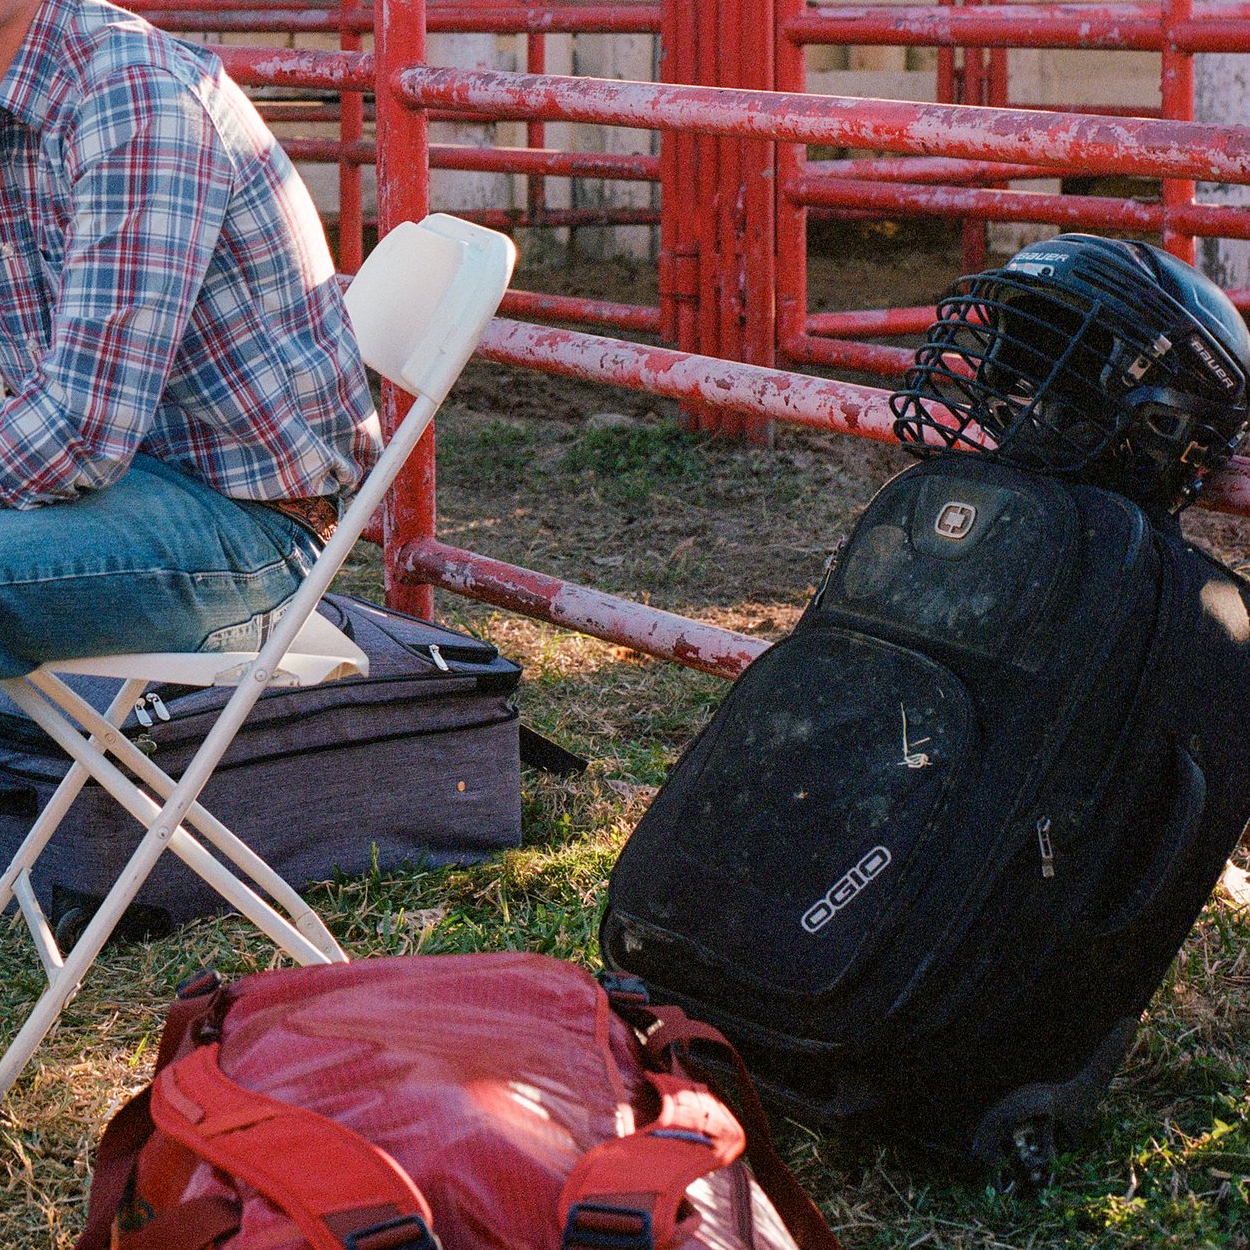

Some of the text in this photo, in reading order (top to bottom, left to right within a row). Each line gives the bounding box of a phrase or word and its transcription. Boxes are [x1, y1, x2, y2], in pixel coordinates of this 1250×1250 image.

[1016, 252, 1069, 262] BAUER
[1191, 340, 1234, 388] BAUER
[801, 846, 892, 932] OGIO
